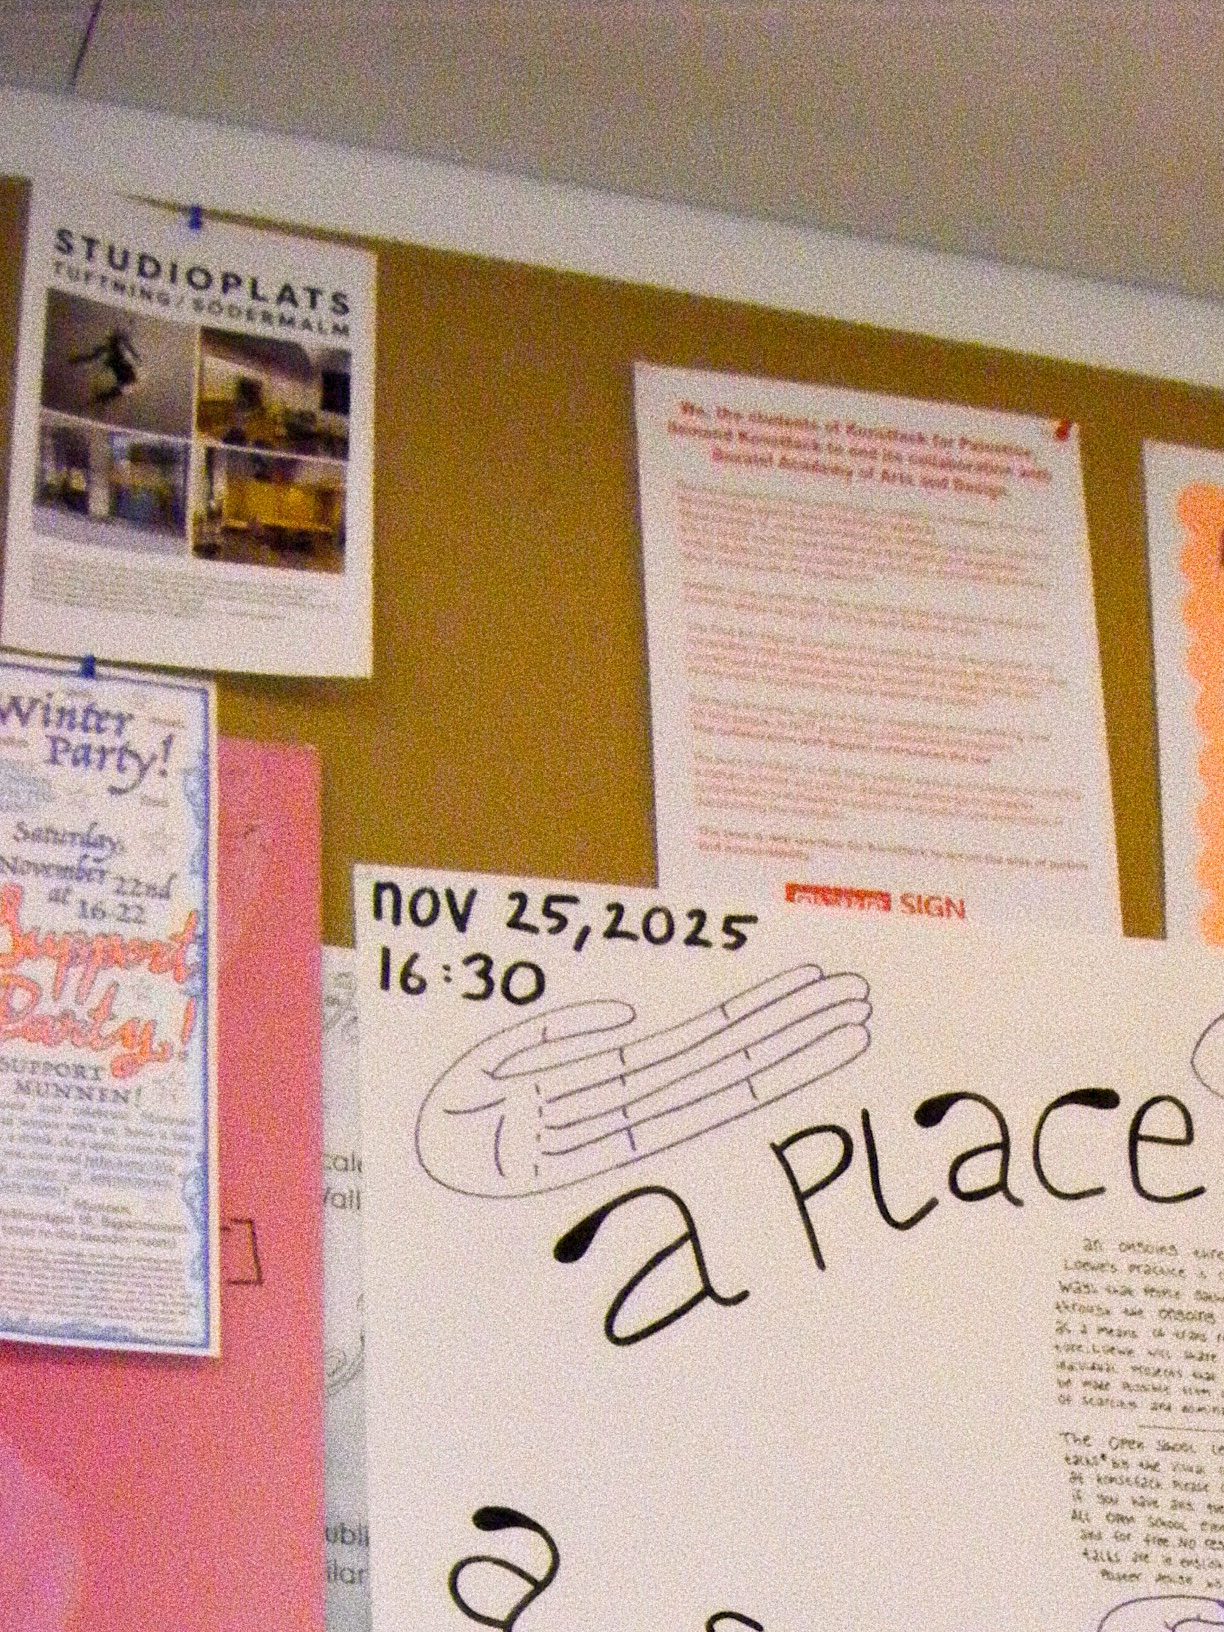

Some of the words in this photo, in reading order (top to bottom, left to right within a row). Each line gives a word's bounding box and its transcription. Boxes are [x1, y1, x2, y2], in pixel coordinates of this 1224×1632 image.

[54, 228, 351, 316] STUDIOPLATS
[0, 692, 135, 737] Winter
[45, 733, 175, 796] Party!
[900, 891, 968, 922] SIGN
[379, 946, 546, 1005] 16:30
